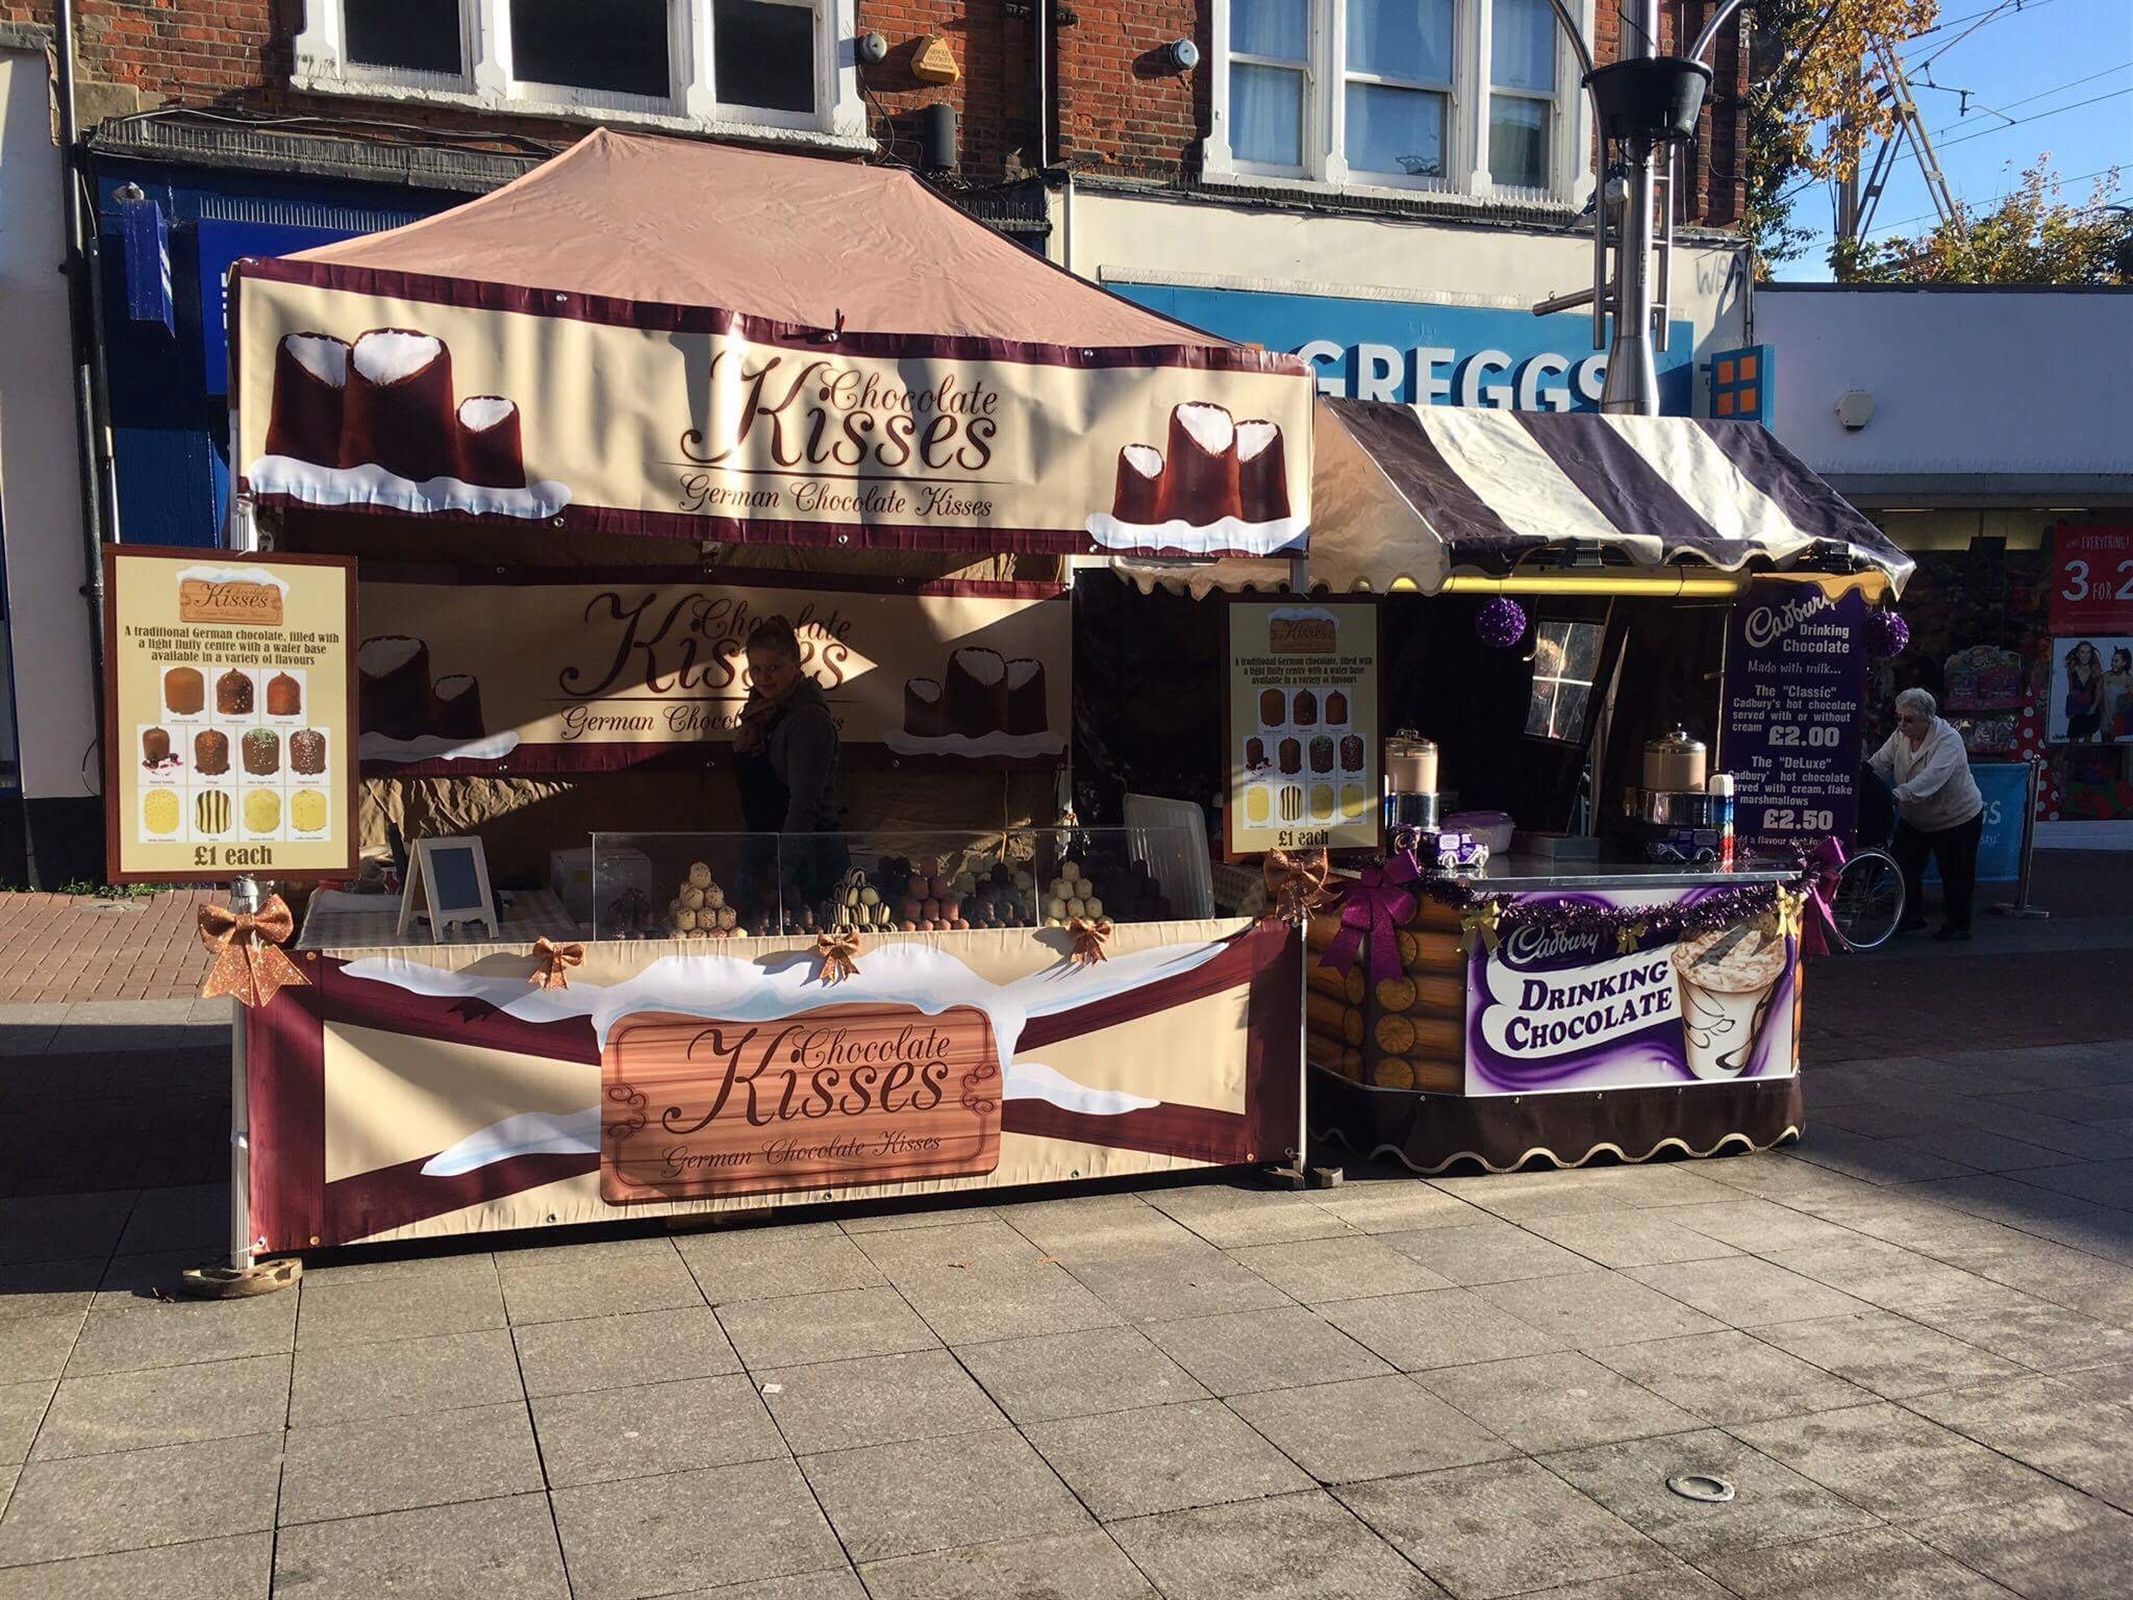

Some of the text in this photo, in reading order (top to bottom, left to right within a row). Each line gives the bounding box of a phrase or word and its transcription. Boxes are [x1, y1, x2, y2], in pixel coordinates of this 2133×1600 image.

[820, 367, 998, 415] Chocolate
[680, 349, 996, 471] Kisses
[678, 473, 993, 517] German Chocolate Kisses
[2062, 559, 2133, 601] 3 FOR 2
[195, 583, 269, 608] Kisses
[692, 597, 851, 640] Cholate
[125, 626, 339, 643] A traditional German chocolate, filled with
[1800, 624, 1850, 639] Drinking
[139, 639, 326, 654] a light fluffy centre with a wafer base
[558, 592, 848, 696] Kises
[1783, 638, 1850, 654] Chocolate
[151, 651, 315, 666] available in a variety of flavours
[1747, 660, 1842, 675] Made with milk...
[1755, 685, 1837, 699] The "Classic"
[1733, 698, 1857, 711] Cadbury's hot chocolate
[560, 705, 742, 741] German Chocol
[1732, 710, 1851, 723] served with or without
[1732, 723, 1762, 732] cream
[1768, 725, 1840, 747] £2.00
[1751, 756, 1772, 769] The
[1780, 772, 1796, 782] hot
[1802, 773, 1850, 783] chocolate
[1733, 782, 1853, 796] erved with cream, flake
[1740, 795, 1809, 806] marshmallows
[1763, 809, 1833, 830] £2.50
[1278, 829, 1329, 847] £1 each
[1758, 836, 1786, 845] flavour
[194, 845, 272, 866] £1 each
[1507, 925, 1599, 965] Cadbury
[1518, 960, 1669, 1012] DRINKING
[1504, 987, 1672, 1051] CHOCOLATE
[793, 1023, 951, 1069] Chocolate
[661, 1024, 949, 1135] Kisses
[661, 1129, 941, 1179] German Chocolate Kisses
